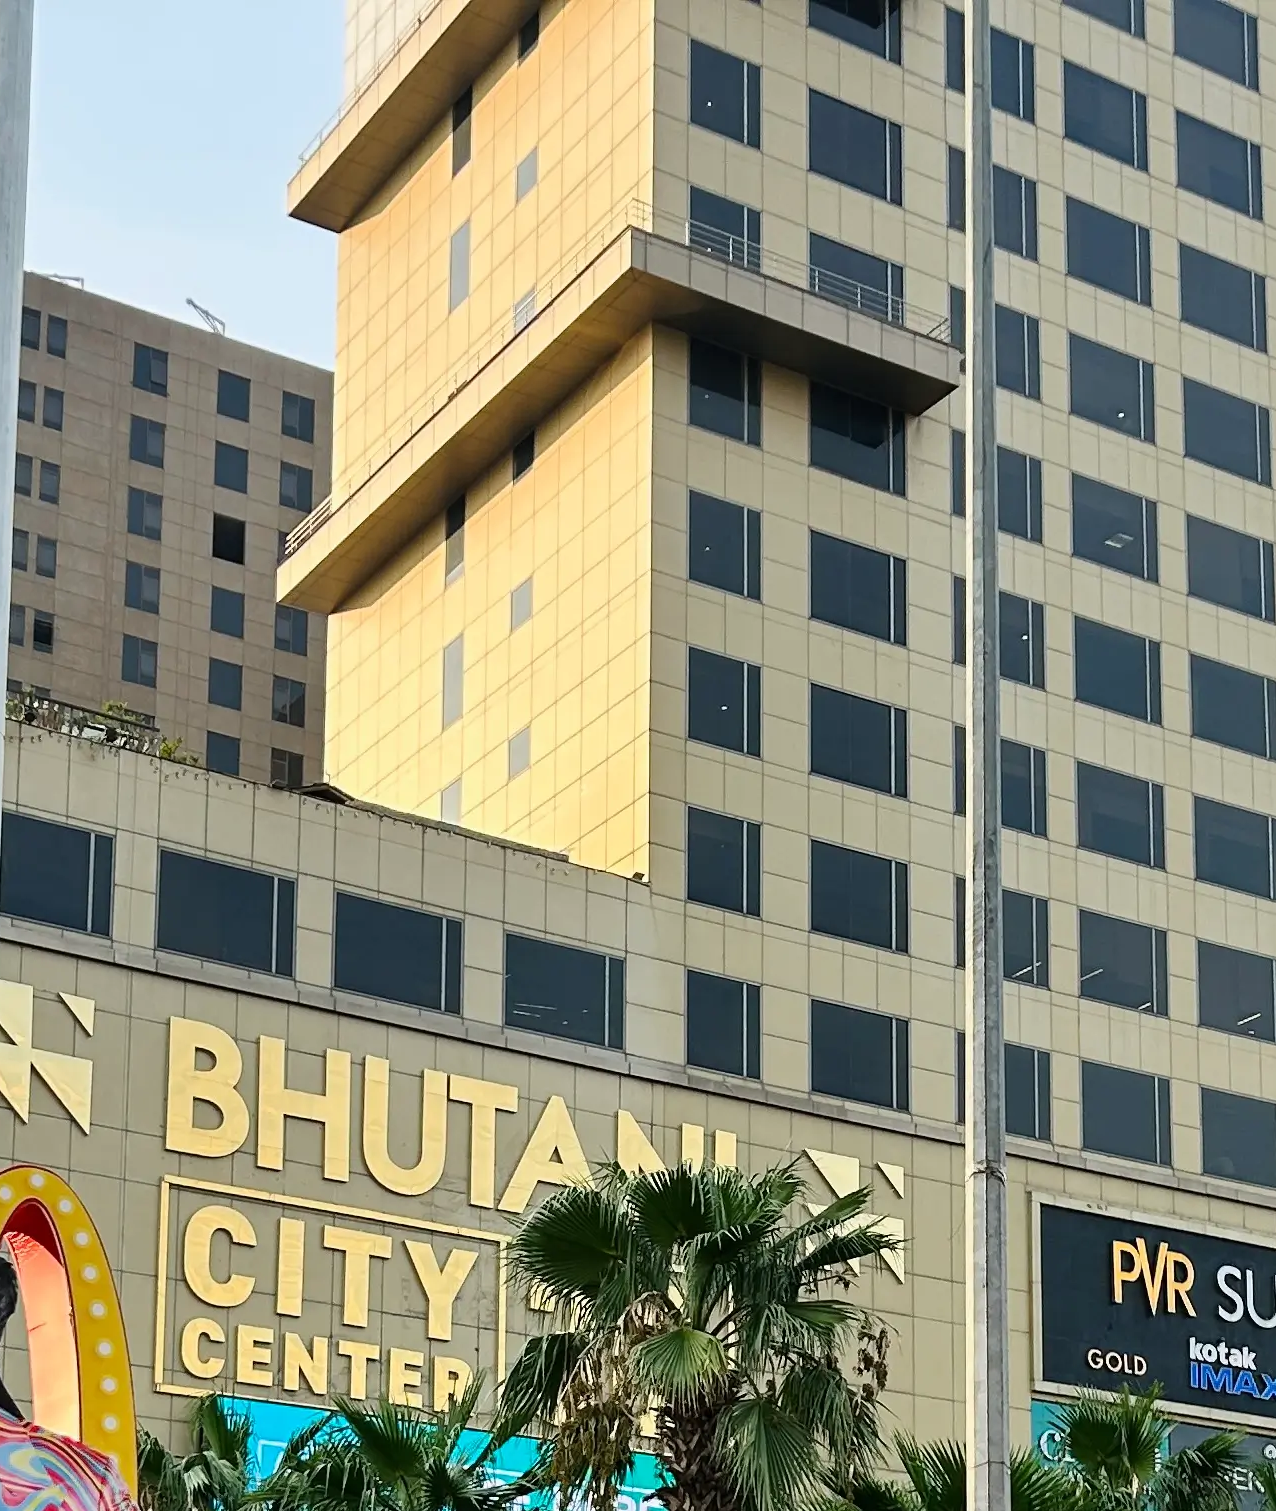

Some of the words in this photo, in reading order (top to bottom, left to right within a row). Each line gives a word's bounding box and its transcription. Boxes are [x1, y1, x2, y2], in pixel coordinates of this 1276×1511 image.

[181, 1205, 479, 1342] CITY
[1111, 1236, 1198, 1318] PVR
[179, 1318, 474, 1413] CENTER
[1086, 1348, 1148, 1377] GOLD
[1188, 1336, 1258, 1370] kotak
